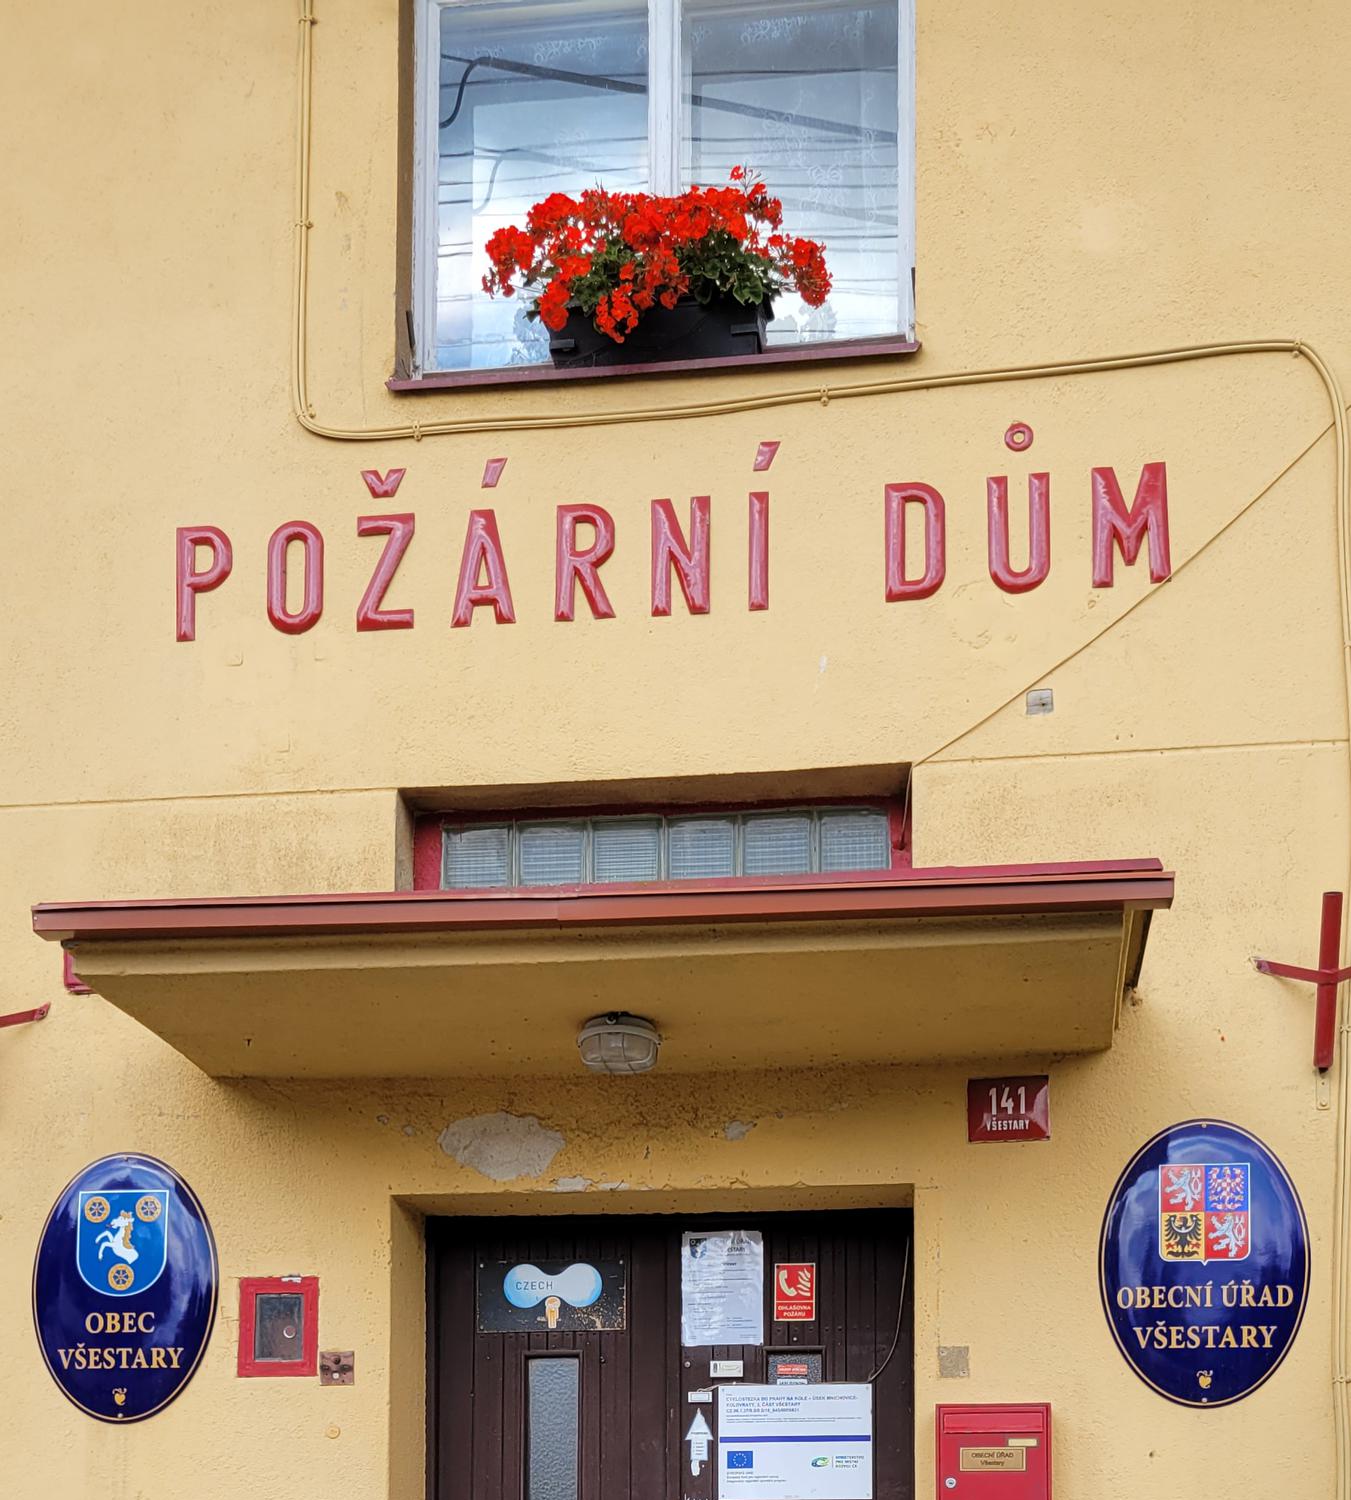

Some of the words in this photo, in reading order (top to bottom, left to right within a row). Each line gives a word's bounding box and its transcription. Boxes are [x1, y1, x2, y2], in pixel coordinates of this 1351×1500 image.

[176, 441, 781, 642] POŽÁRNÍ
[884, 422, 1172, 602] DŮM
[989, 1086, 1026, 1116] 141
[986, 1117, 1030, 1131] VŠESTARY
[515, 1281, 553, 1291] CZECH
[1116, 1280, 1213, 1310] OBECNÍ
[1220, 1279, 1294, 1309] ÚŘAD
[85, 1312, 156, 1334] OBEC
[1132, 1320, 1278, 1350] VŠESTARY
[57, 1342, 184, 1370] VŠESTARY
